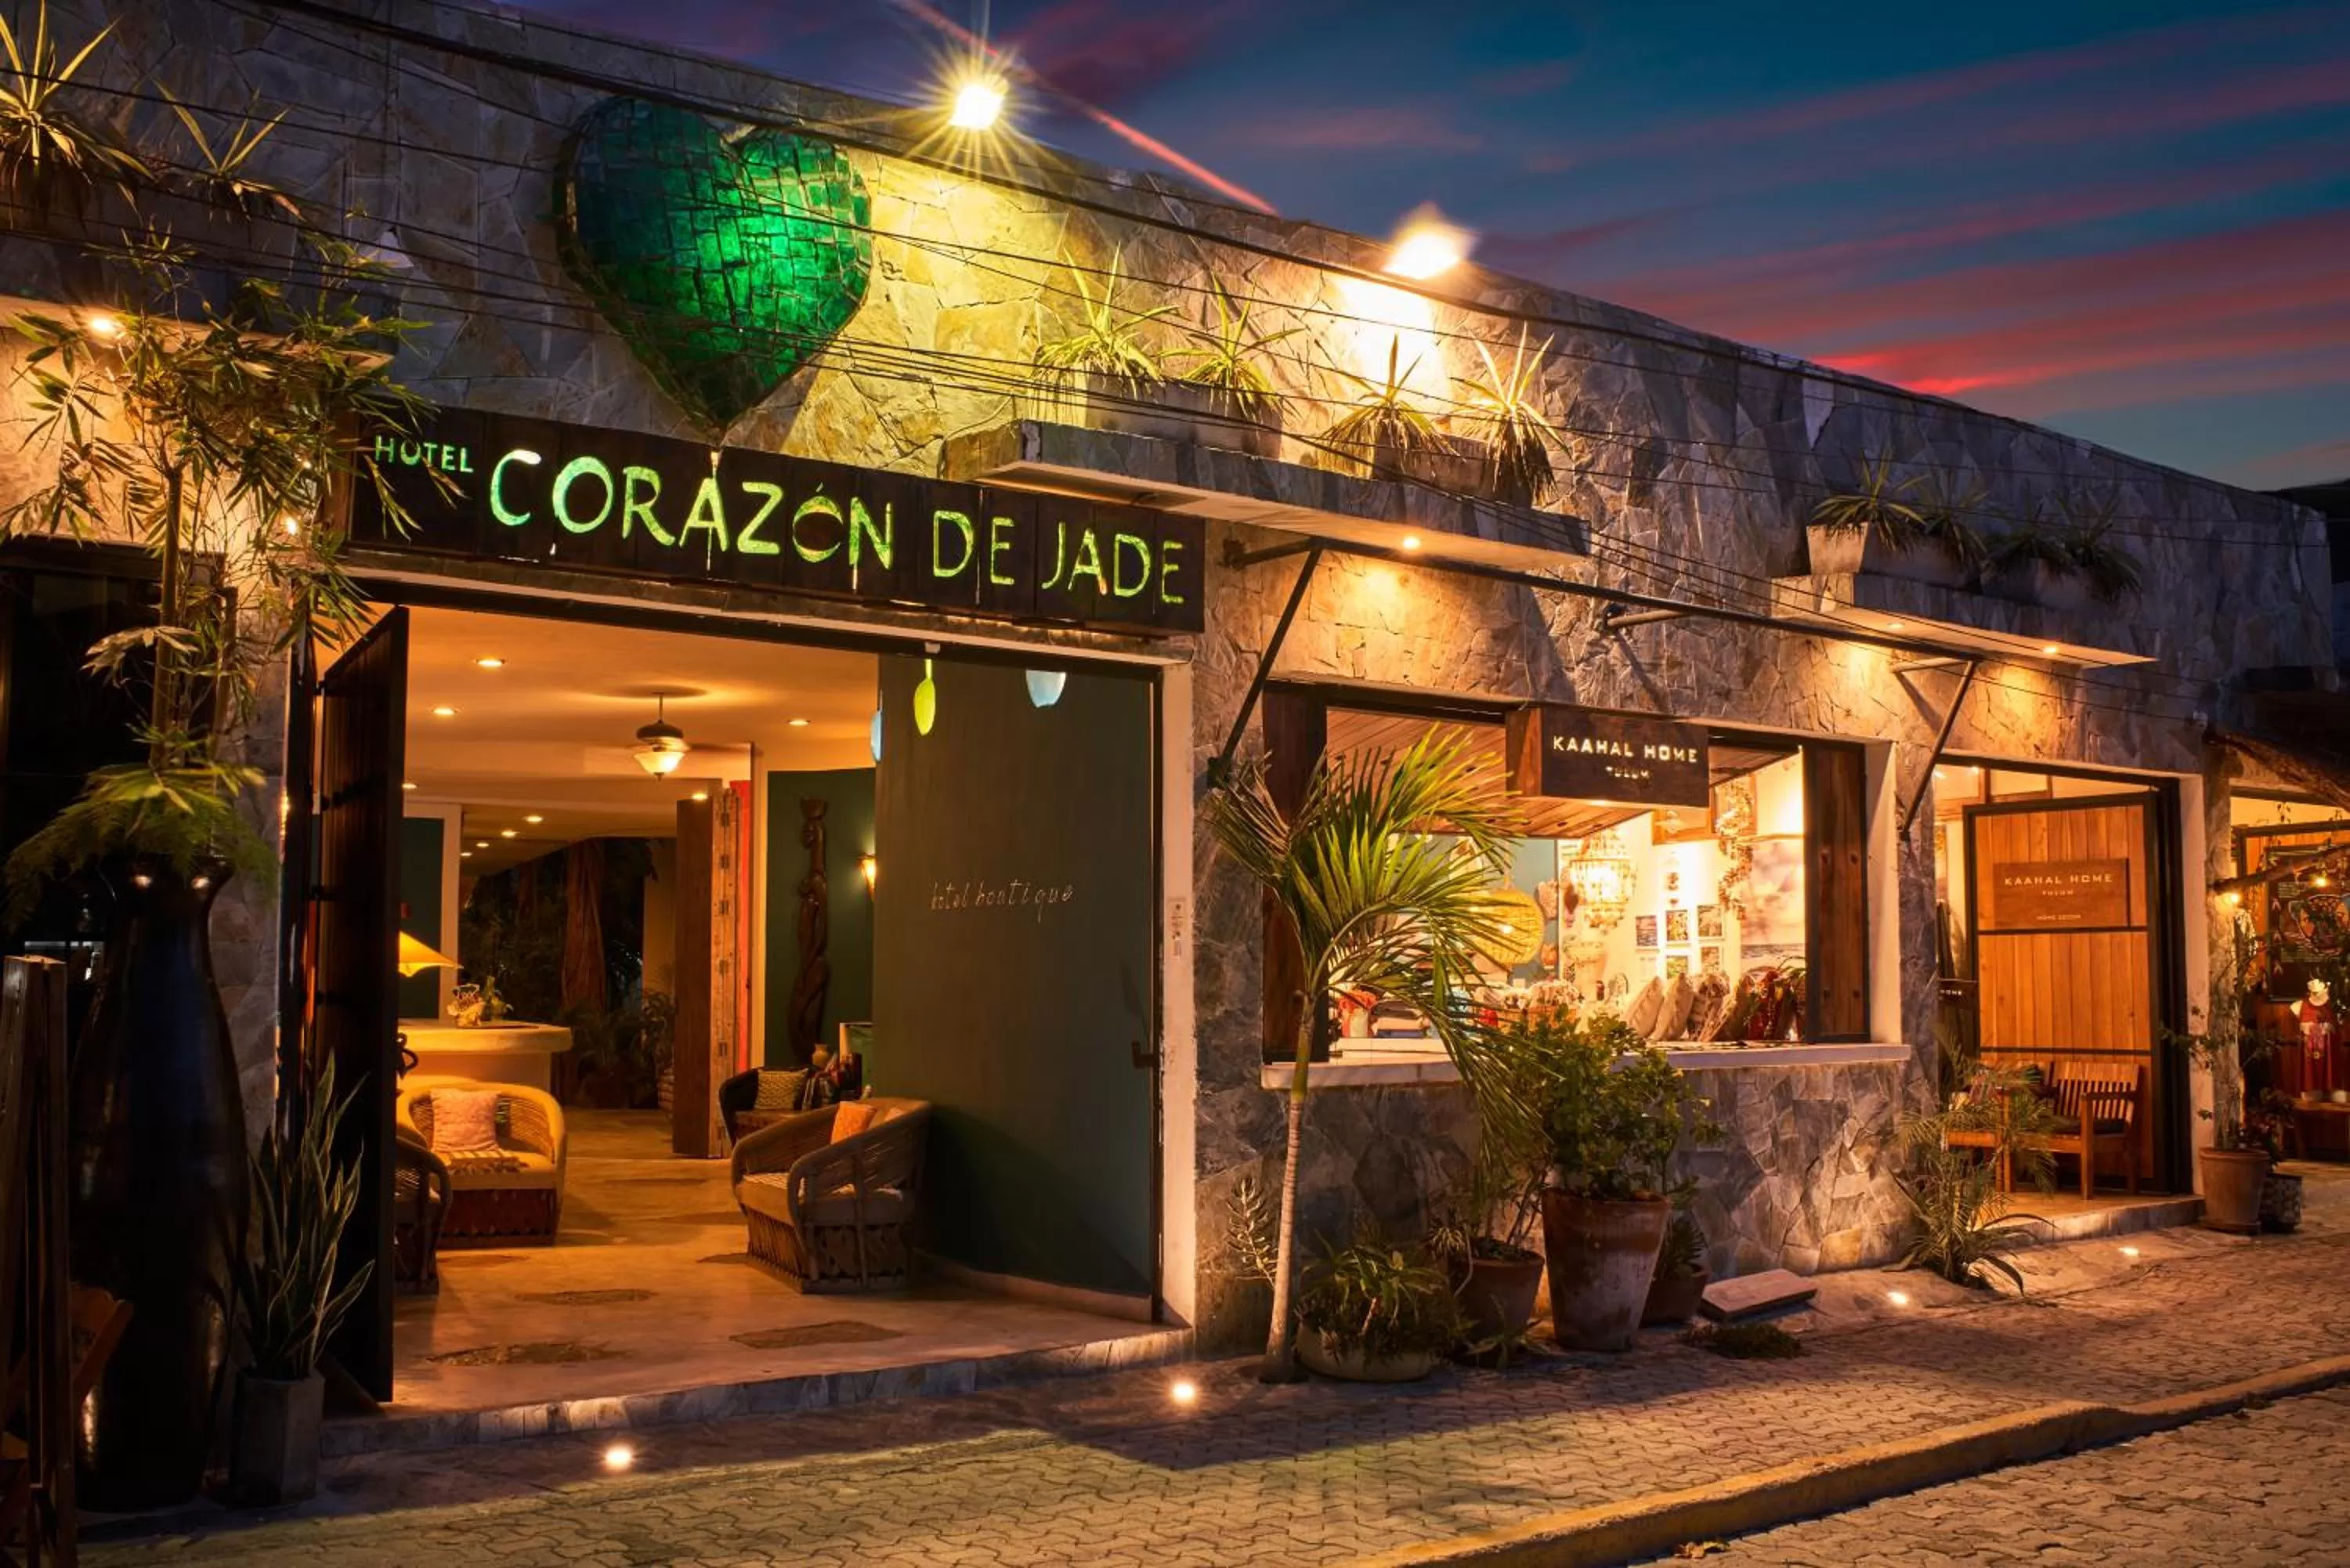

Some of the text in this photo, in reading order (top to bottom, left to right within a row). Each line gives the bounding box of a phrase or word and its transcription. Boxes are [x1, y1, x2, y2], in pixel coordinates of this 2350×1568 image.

[374, 435, 474, 472] HOTEL
[490, 449, 1185, 603] CORAZÓN DE JADE
[1553, 735, 1698, 764] KAAHAL HOME
[2005, 873, 2113, 886] KAAHAL HOME
